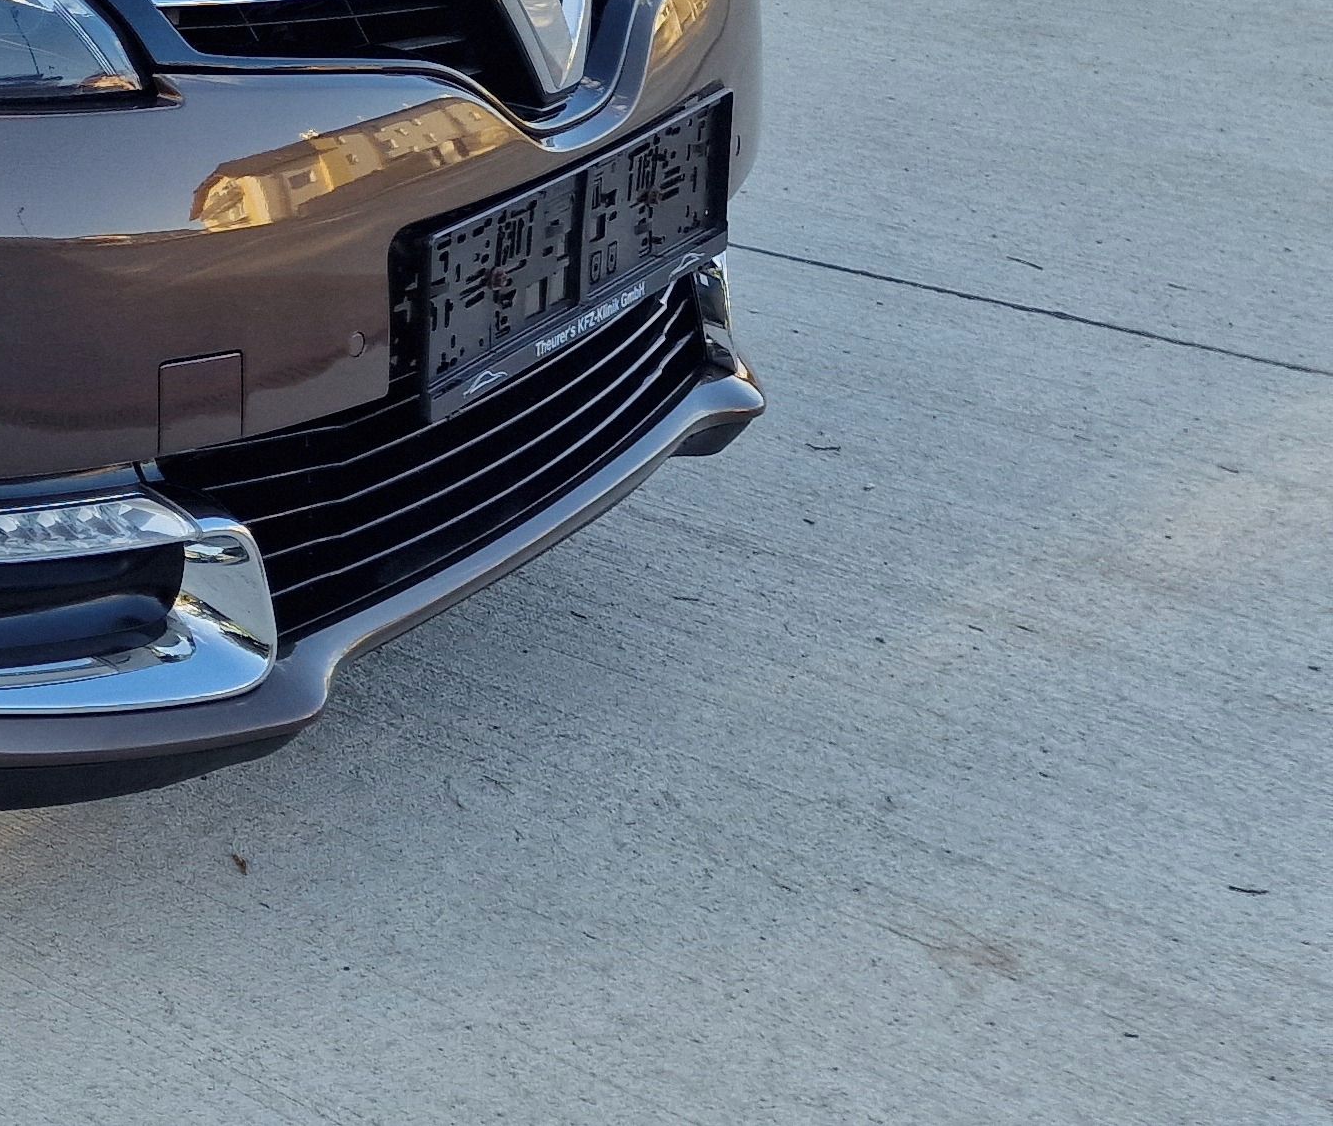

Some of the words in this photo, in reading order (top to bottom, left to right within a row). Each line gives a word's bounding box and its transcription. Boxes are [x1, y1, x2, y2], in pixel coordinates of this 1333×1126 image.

[535, 324, 576, 357] Theurer's
[577, 298, 620, 334] KFZ-Klinik
[620, 281, 646, 307] GmbH
